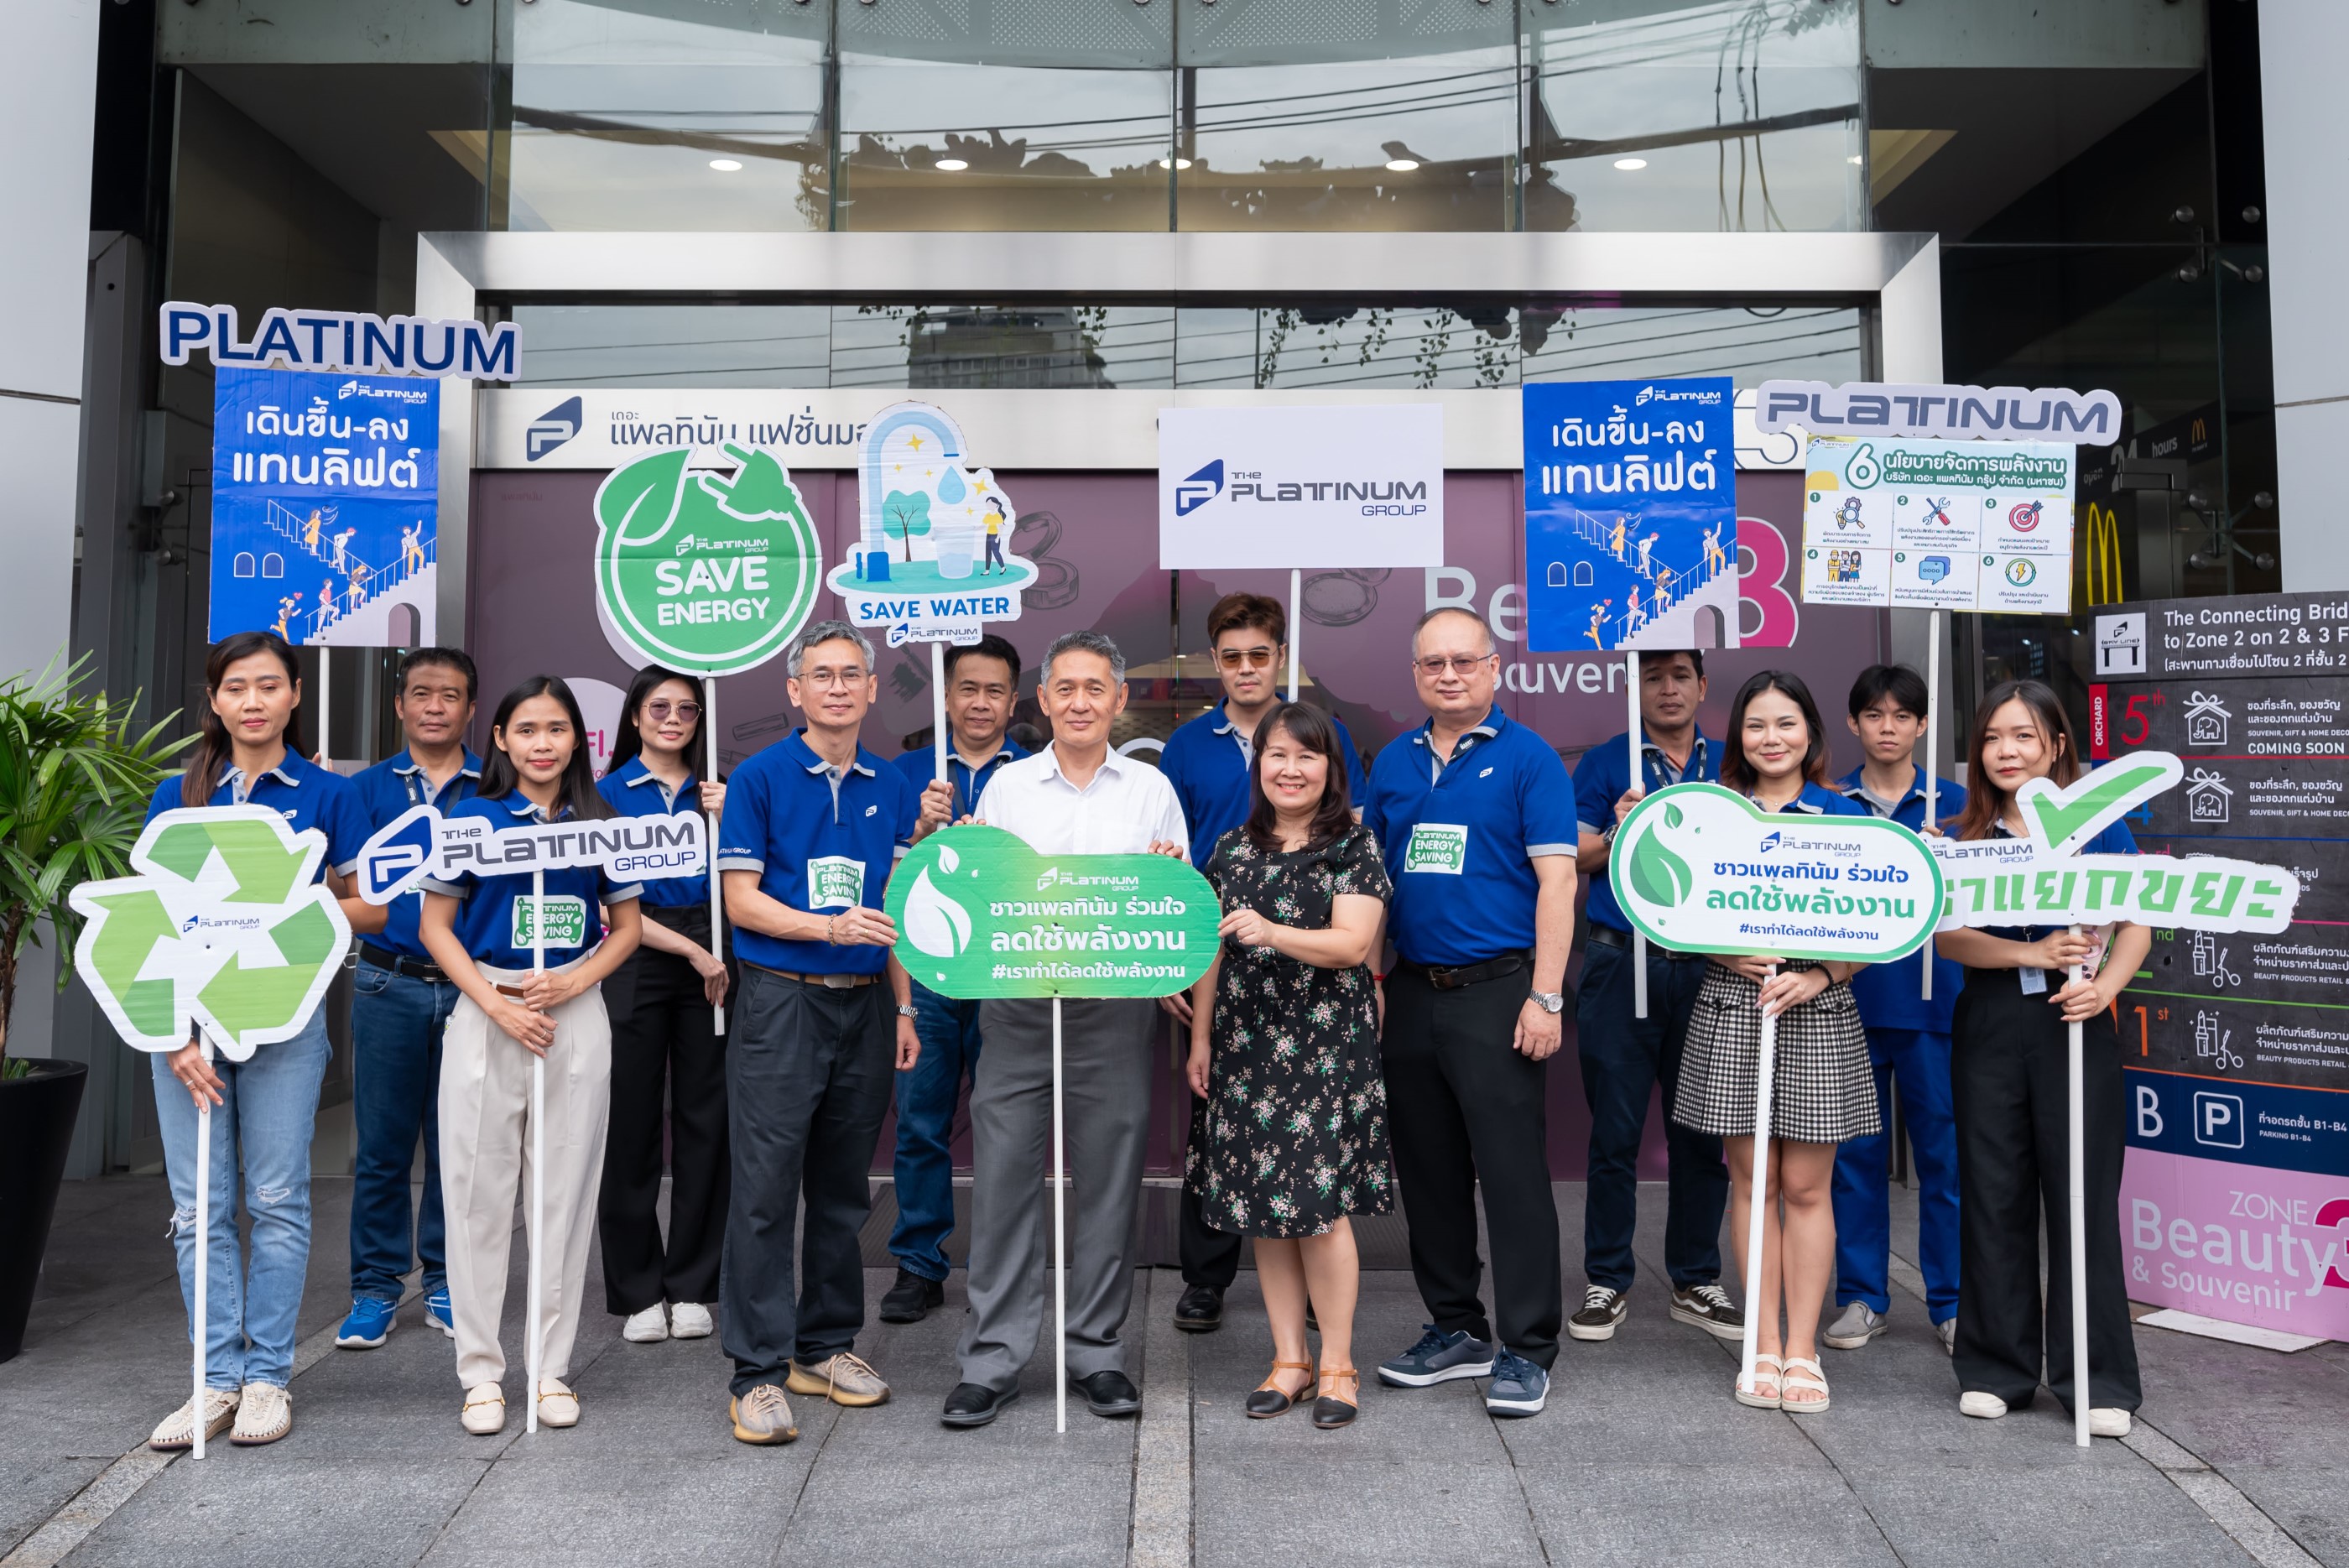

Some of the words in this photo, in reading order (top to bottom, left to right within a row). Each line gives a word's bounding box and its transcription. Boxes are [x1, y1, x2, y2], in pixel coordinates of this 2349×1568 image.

[169, 310, 517, 375] PLATINUM
[357, 388, 428, 400] PLATINUM
[1654, 392, 1721, 402] PLATINUM
[247, 397, 409, 441] เดินขึ้น-ลง
[612, 411, 639, 420] เดอะ
[1768, 392, 2109, 434] PLATINUM
[611, 414, 737, 445] แพลทินัม
[1552, 404, 1705, 448] เดินขึ้น-ลง
[2152, 437, 2178, 458] hours
[232, 447, 421, 488] แทนลิฟต์
[1542, 449, 1716, 495] แทนลิฟต์
[1846, 443, 1881, 490] 6
[1886, 451, 2065, 473] นโยบายจัดการพลังงาน
[1886, 471, 1911, 482] บริษัท
[1231, 481, 1427, 503] PLATINUM
[1362, 504, 1426, 517] GROUP
[695, 539, 768, 551] PLATINUM
[655, 555, 769, 597] SAVE
[657, 596, 770, 626] ENERGY
[859, 599, 921, 620] SAVE
[930, 596, 1010, 617] WATER
[2164, 610, 2194, 627] The
[2201, 604, 2301, 626] Connecting
[910, 628, 977, 638] PLATINUM
[2164, 634, 2180, 649] to
[2185, 633, 2227, 649] Zone
[2234, 630, 2244, 646] 2
[2250, 632, 2273, 645] on
[2279, 628, 2290, 644] 2
[2297, 628, 2311, 643] &
[2319, 627, 2330, 643] 3
[2164, 653, 2289, 672] (สะพานทางเชื่อมไปโซน
[2294, 654, 2301, 667] 2
[2305, 649, 2333, 667] ที่ชั้น
[2338, 654, 2346, 666] 2
[2300, 699, 2341, 711] ของขวัญ
[2095, 696, 2103, 746] ORCHARD
[2248, 711, 2332, 723] และของตกแต่งบ้าน
[2248, 742, 2302, 754] COMING
[2305, 742, 2345, 754] SOON
[2302, 780, 2342, 792] ของขวัญ
[2249, 793, 2335, 804] และของตกแต่งบ้าน
[443, 822, 695, 868] PLATINUM
[1415, 840, 1455, 851] ENERGY
[1783, 840, 1861, 852] PLATINUM
[615, 851, 696, 872] GROUP
[1414, 852, 1453, 863] SAVING
[821, 873, 856, 887] ENERGY
[1060, 875, 1139, 886] PLATINUM
[1714, 861, 1839, 882] ชาวแพลทินัม
[1848, 864, 1909, 883] ร่วมใจ
[990, 896, 1117, 917] ชาวแพลทินัม
[1126, 895, 1185, 917] ร่วมใจ
[1706, 884, 1915, 918] ลดใช้พลังงาน
[526, 913, 574, 925] EERGY
[525, 925, 573, 937] SVING
[990, 923, 1185, 952] ลดใช้พลังงาน
[1739, 923, 1878, 940] #เราทำได้ลดใช้พลังงาน
[992, 961, 1185, 980] #เราทำได้ลดใช้พลังงาน
[2253, 972, 2279, 981] BEAUTY
[2281, 974, 2317, 983] PRODUCTS
[2257, 1055, 2282, 1063] BEAUTY
[2284, 1056, 2320, 1066] PRODUCTS
[2321, 1060, 2346, 1068] RETAIL
[2137, 1085, 2164, 1138] B
[2259, 1111, 2310, 1128] ที่จอดรถชั้น
[2314, 1120, 2347, 1132] B1-B4
[2259, 1130, 2289, 1139] PARKING
[2290, 1133, 2311, 1142] B1-B4
[2228, 1190, 2309, 1226] ZONE
[2132, 1198, 2338, 1297] Beauty
[2132, 1255, 2151, 1284] &
[2161, 1262, 2297, 1311] Souvenir
